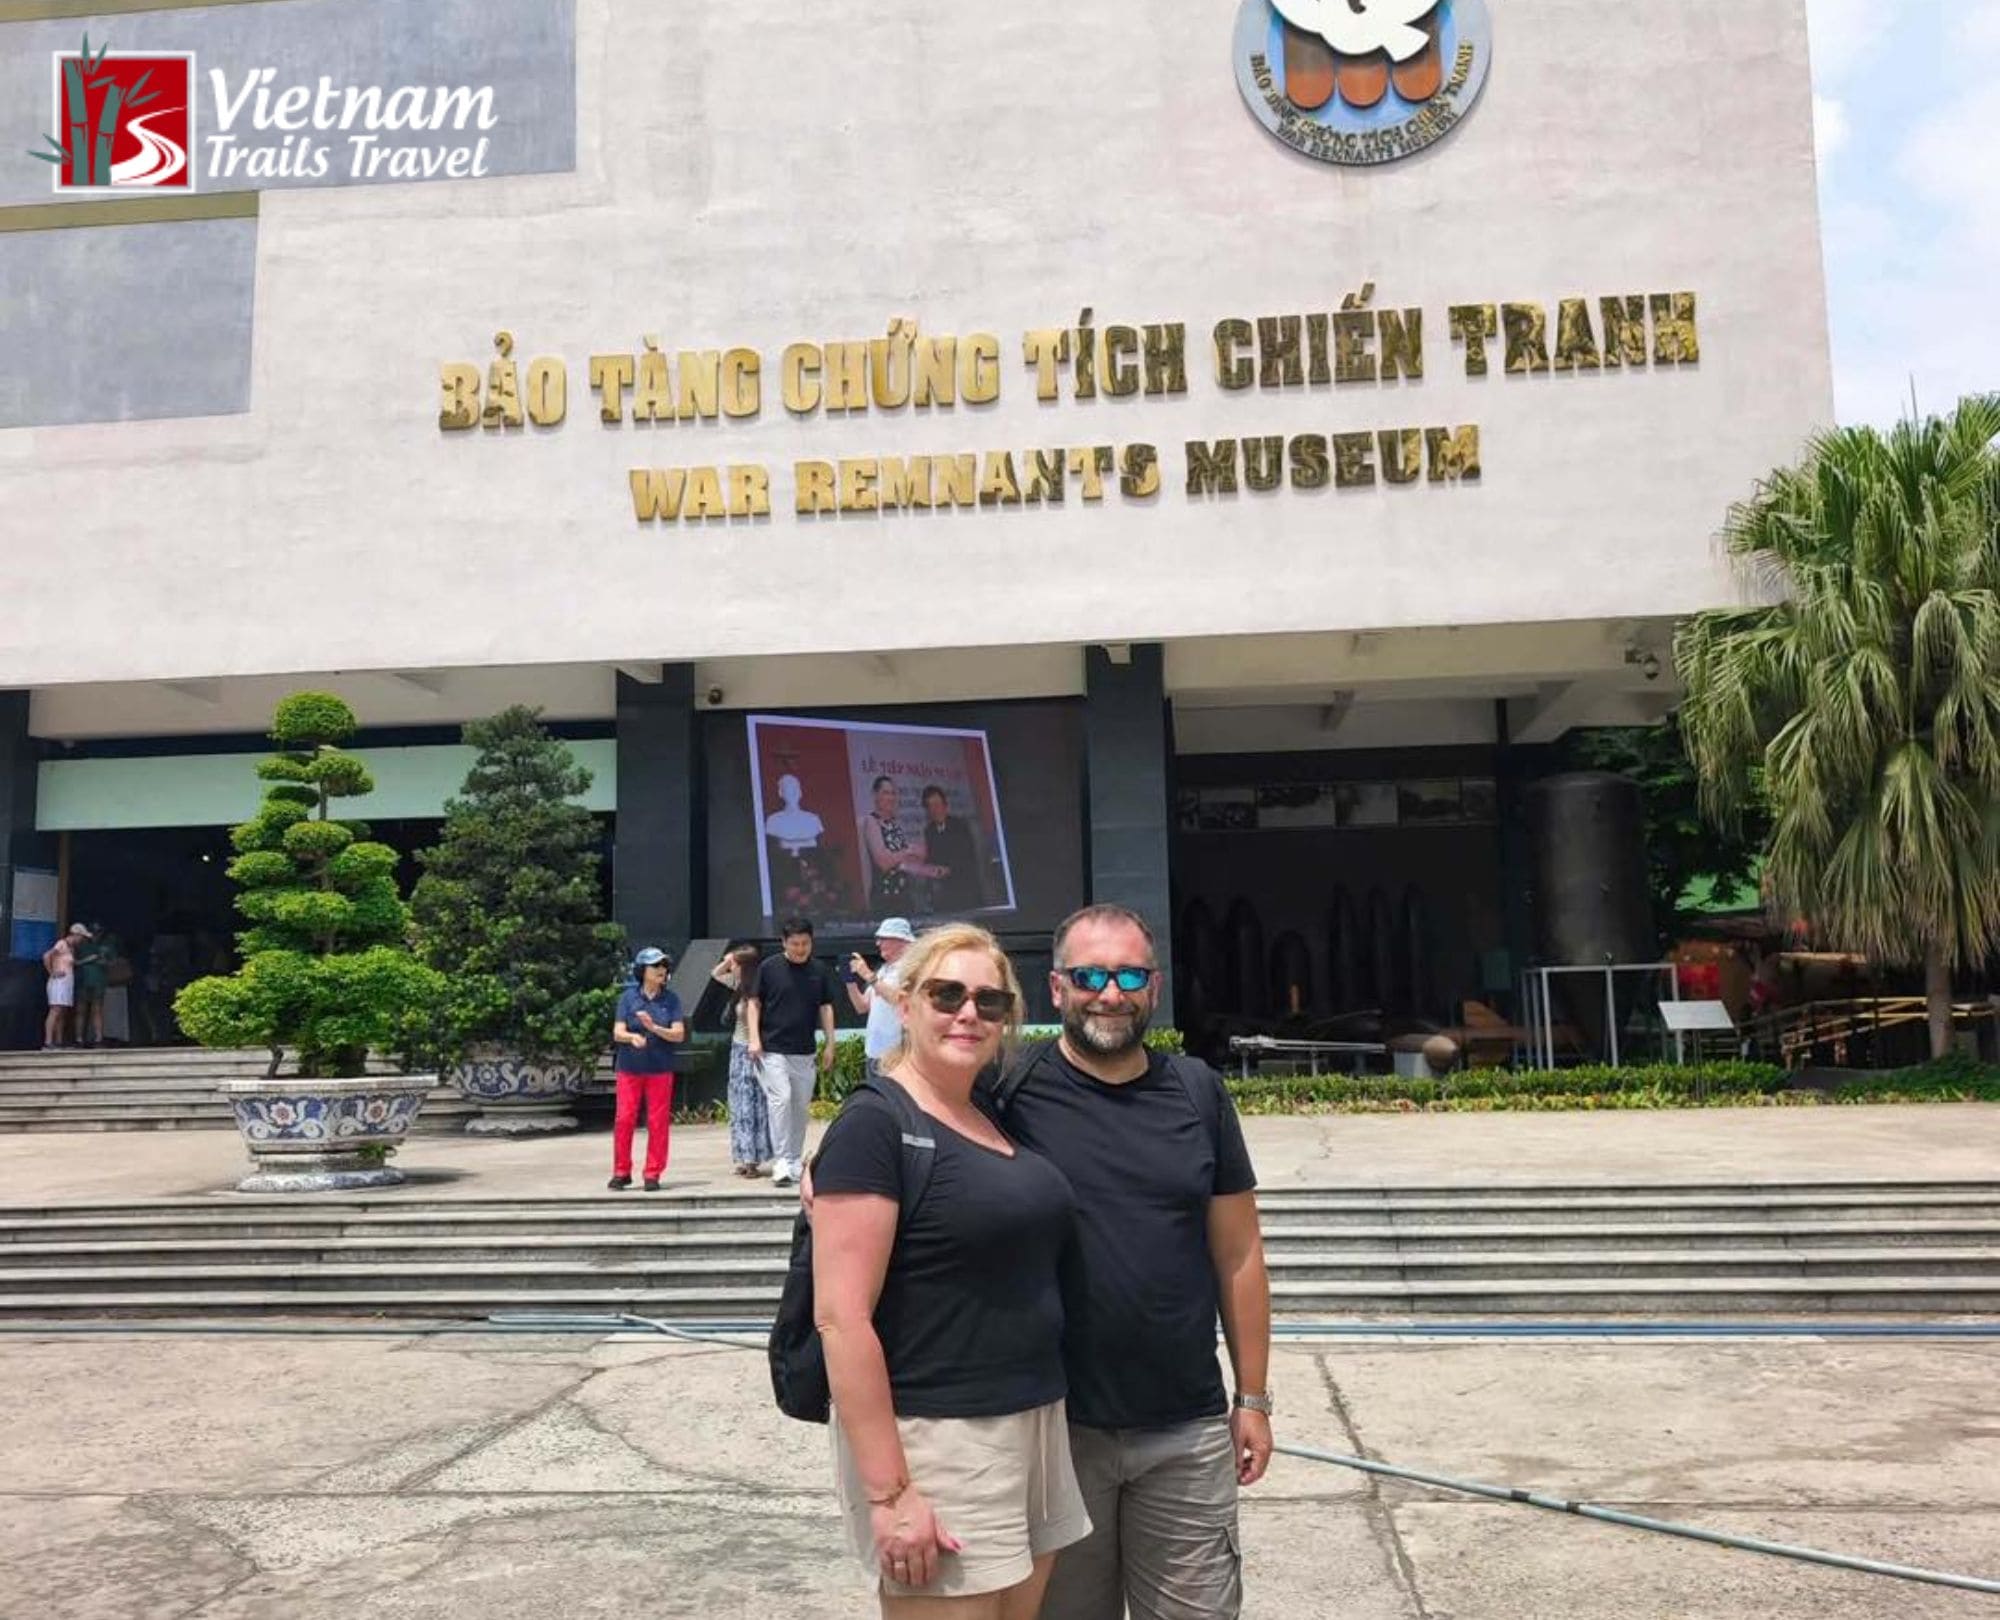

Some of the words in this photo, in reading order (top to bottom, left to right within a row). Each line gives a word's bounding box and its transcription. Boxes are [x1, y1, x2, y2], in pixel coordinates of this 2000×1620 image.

[439, 331, 566, 431] BẢO
[590, 335, 761, 422] TÀNG
[782, 317, 999, 413] CHỨNG
[1023, 307, 1187, 400] TÍCH
[1213, 282, 1423, 389] CHIẾN
[1448, 291, 1699, 376] TRANH
[629, 464, 770, 521] WAR
[794, 443, 1160, 514] REMNANTS
[1185, 424, 1481, 494] MUSEUM
